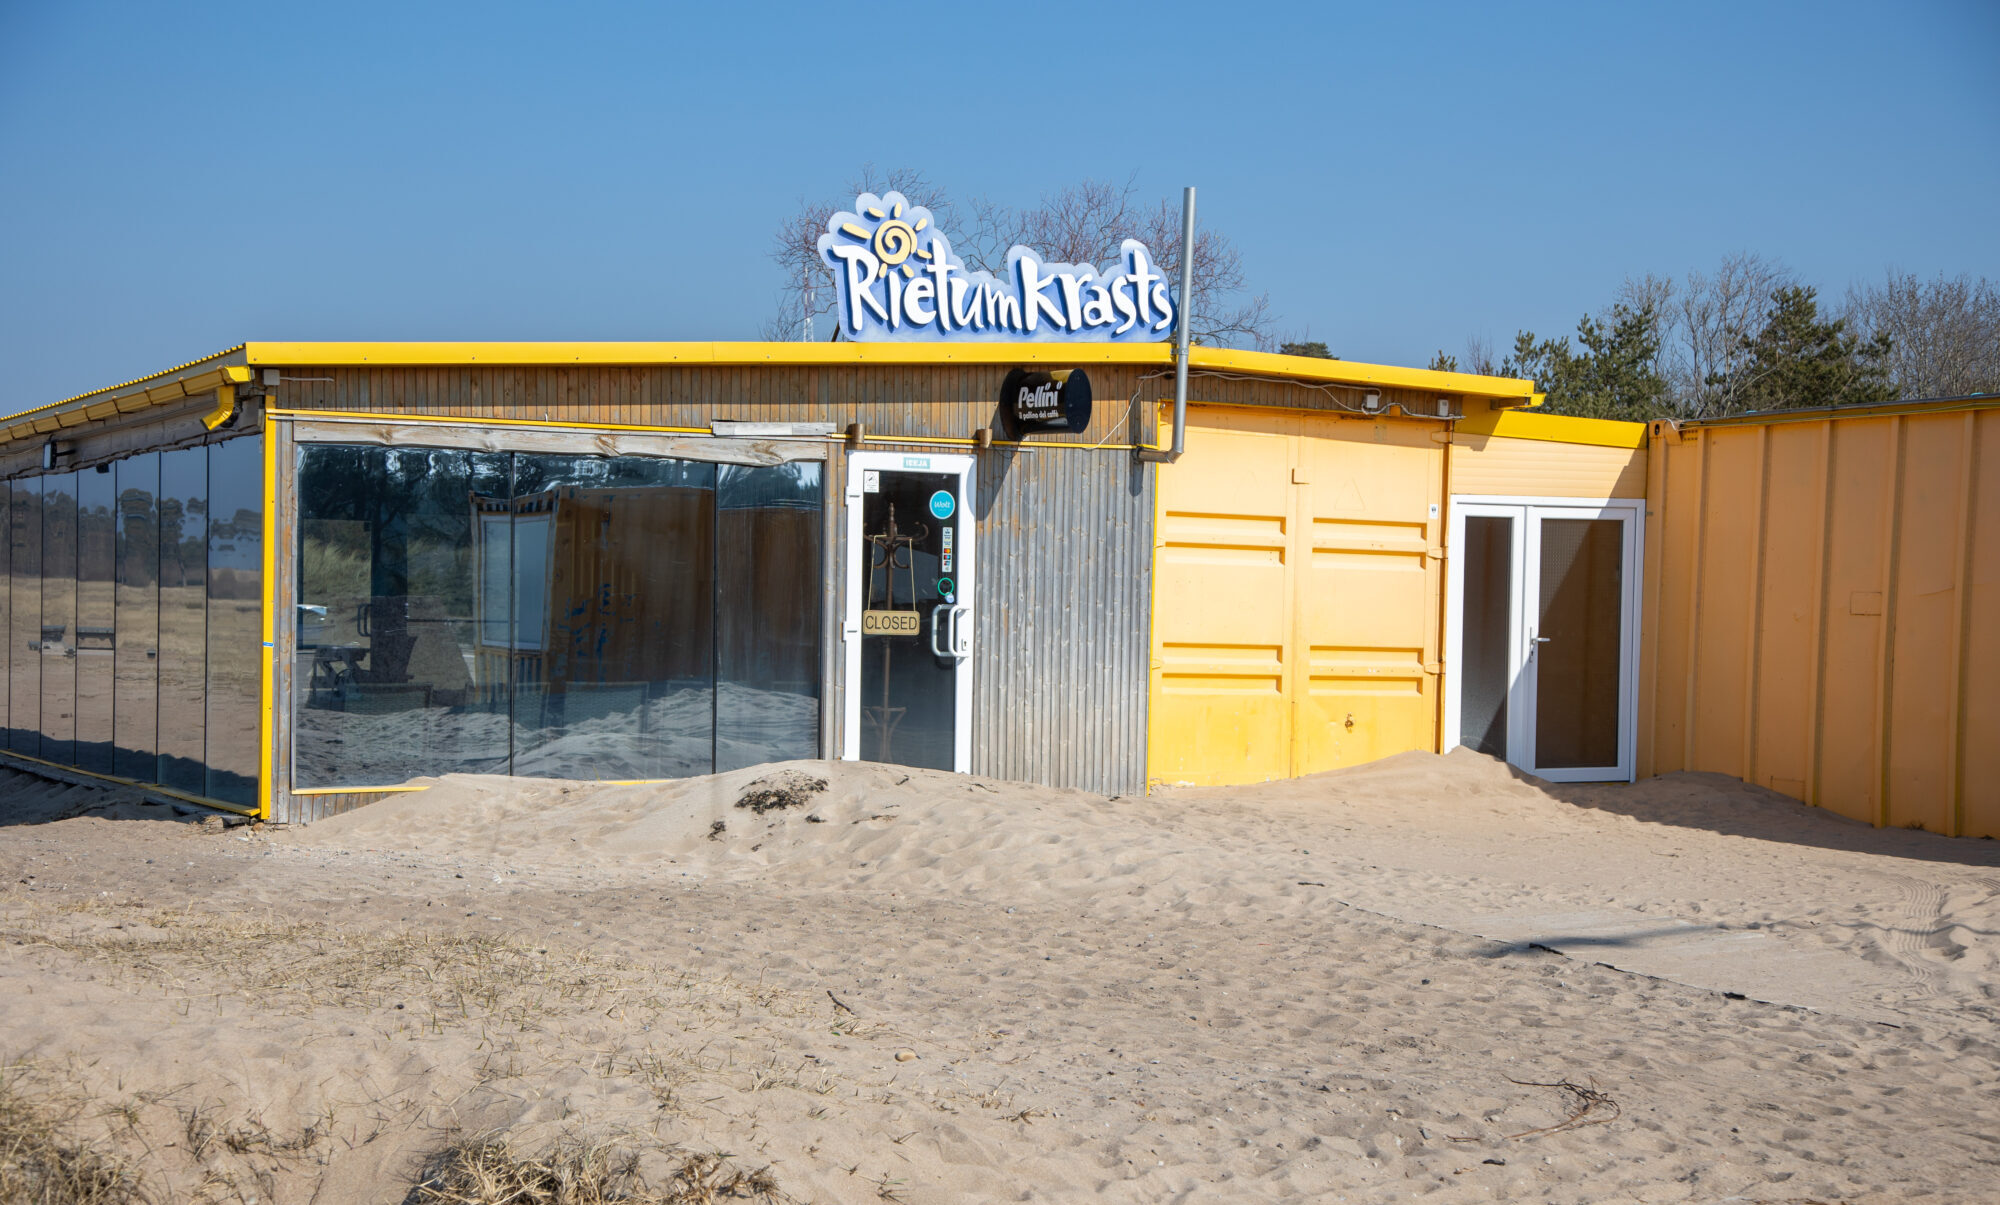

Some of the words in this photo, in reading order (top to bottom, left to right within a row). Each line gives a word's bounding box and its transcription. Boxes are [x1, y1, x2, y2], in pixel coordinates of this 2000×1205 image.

[1018, 380, 1063, 409] Pellini
[934, 500, 951, 509] Wolt
[865, 615, 918, 631] CLOSED
